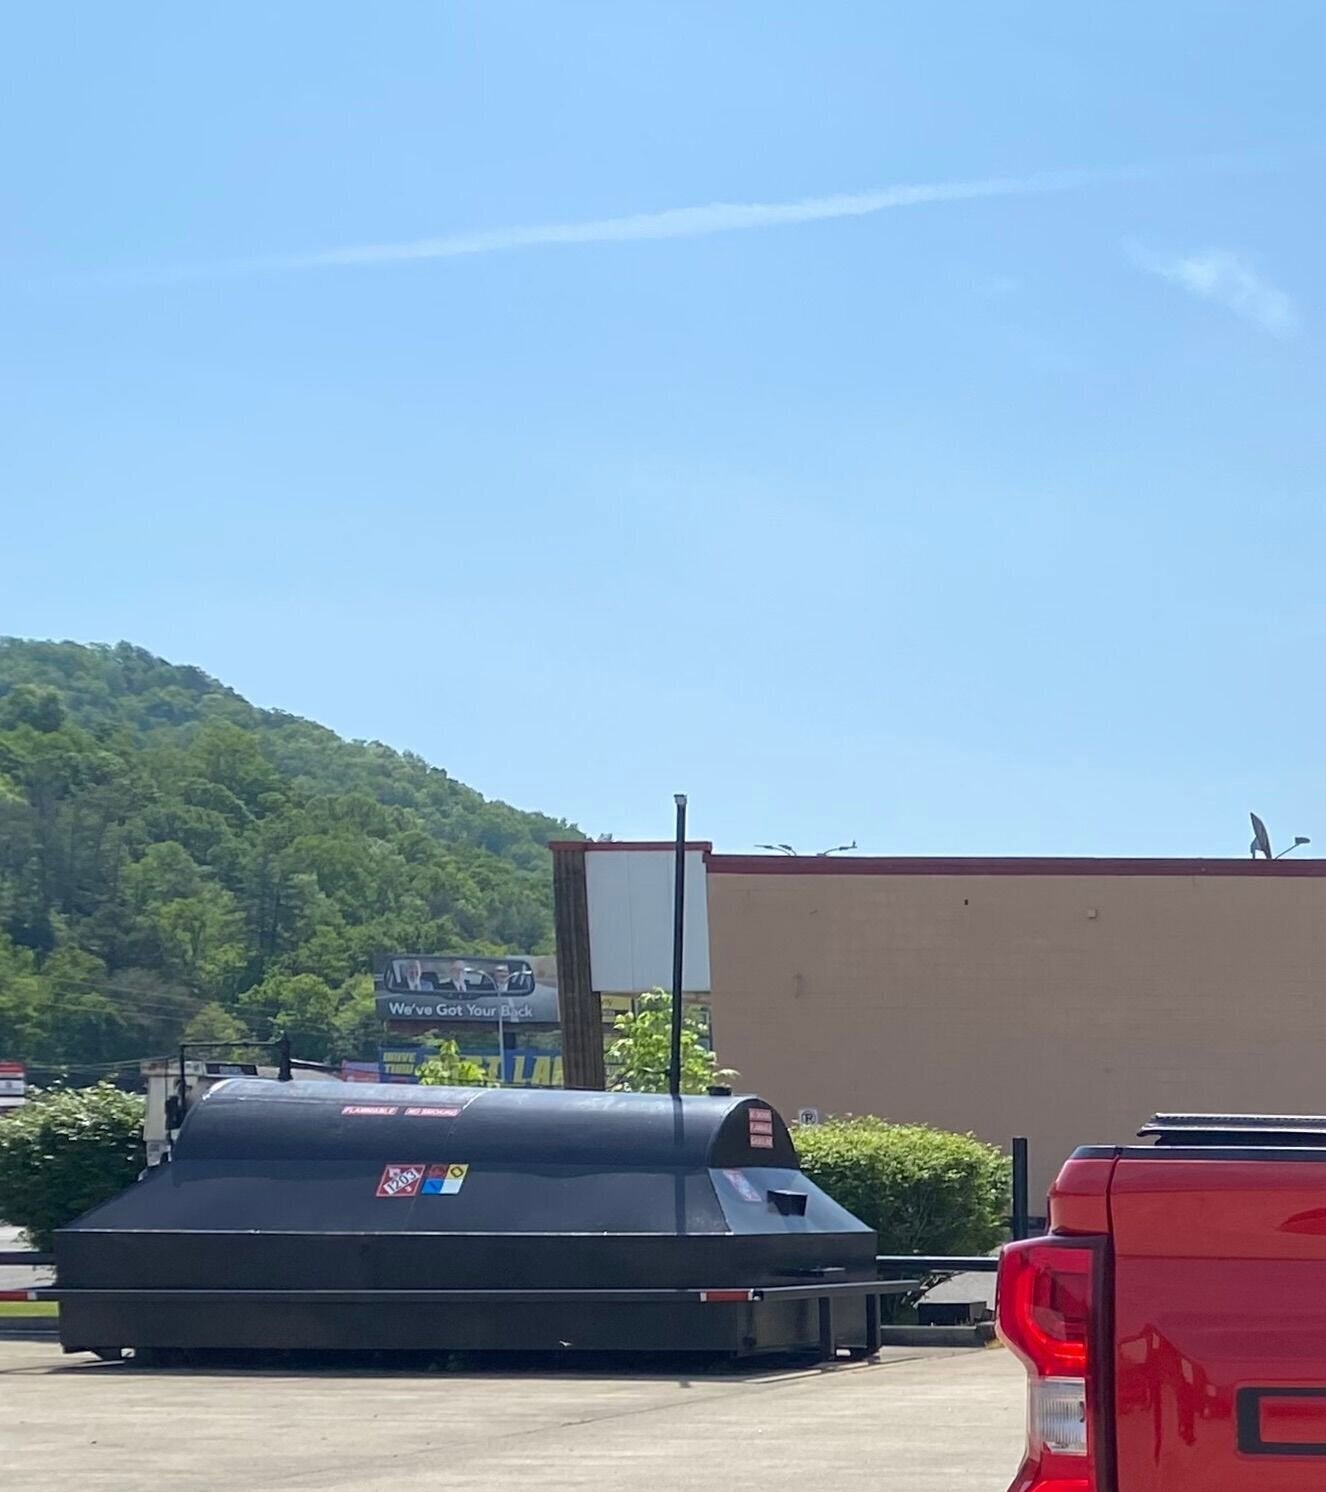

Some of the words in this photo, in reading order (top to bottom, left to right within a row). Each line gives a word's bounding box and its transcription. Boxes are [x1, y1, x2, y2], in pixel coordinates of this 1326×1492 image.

[389, 1002, 433, 1016] We've
[436, 1003, 463, 1016] Got
[466, 1003, 496, 1017] Your
[501, 1004, 532, 1017] Back
[388, 1170, 417, 1192] 1203
